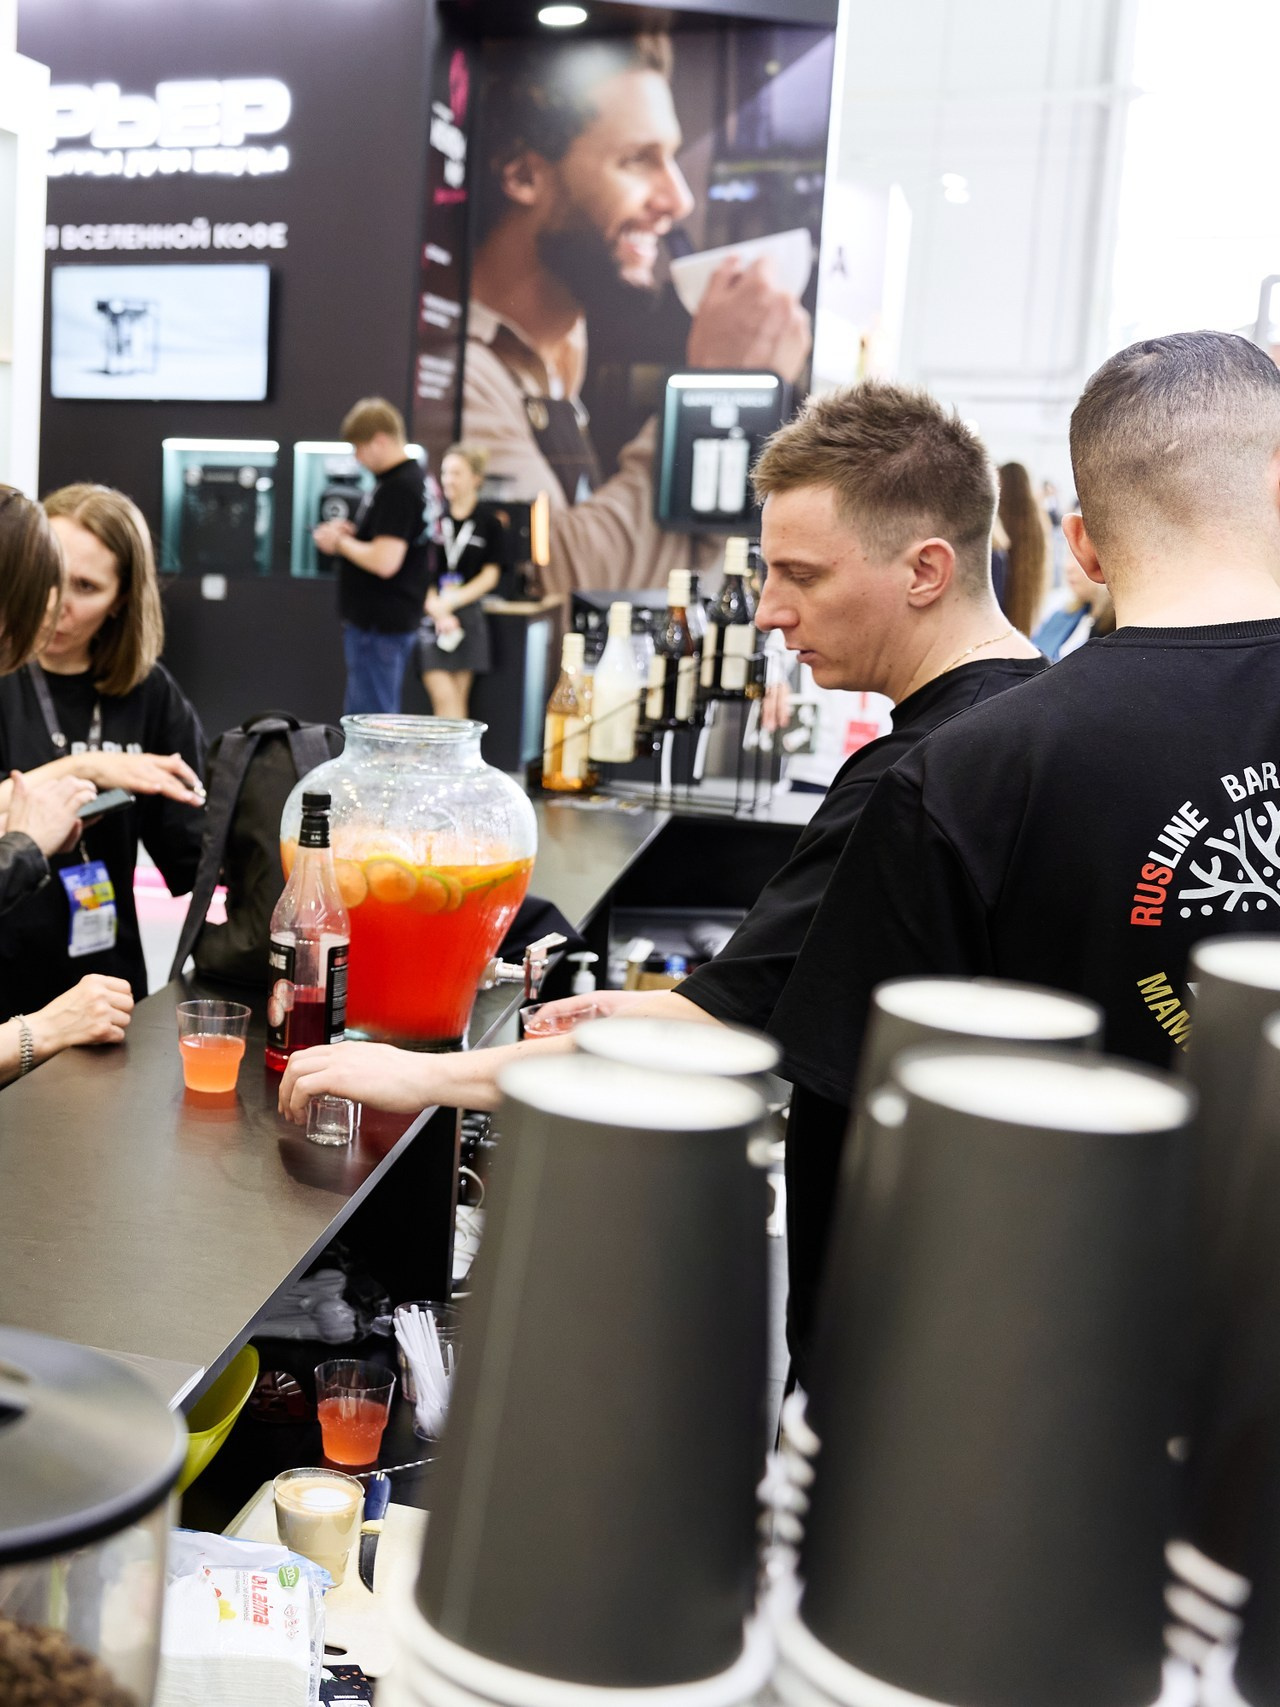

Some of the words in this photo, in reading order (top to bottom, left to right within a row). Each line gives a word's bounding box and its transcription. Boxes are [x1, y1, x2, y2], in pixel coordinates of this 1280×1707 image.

[60, 216, 211, 250] ВСЕЛЕННОЙ
[212, 222, 288, 250] КОФЕ
[1131, 801, 1209, 926] RUSLINE
